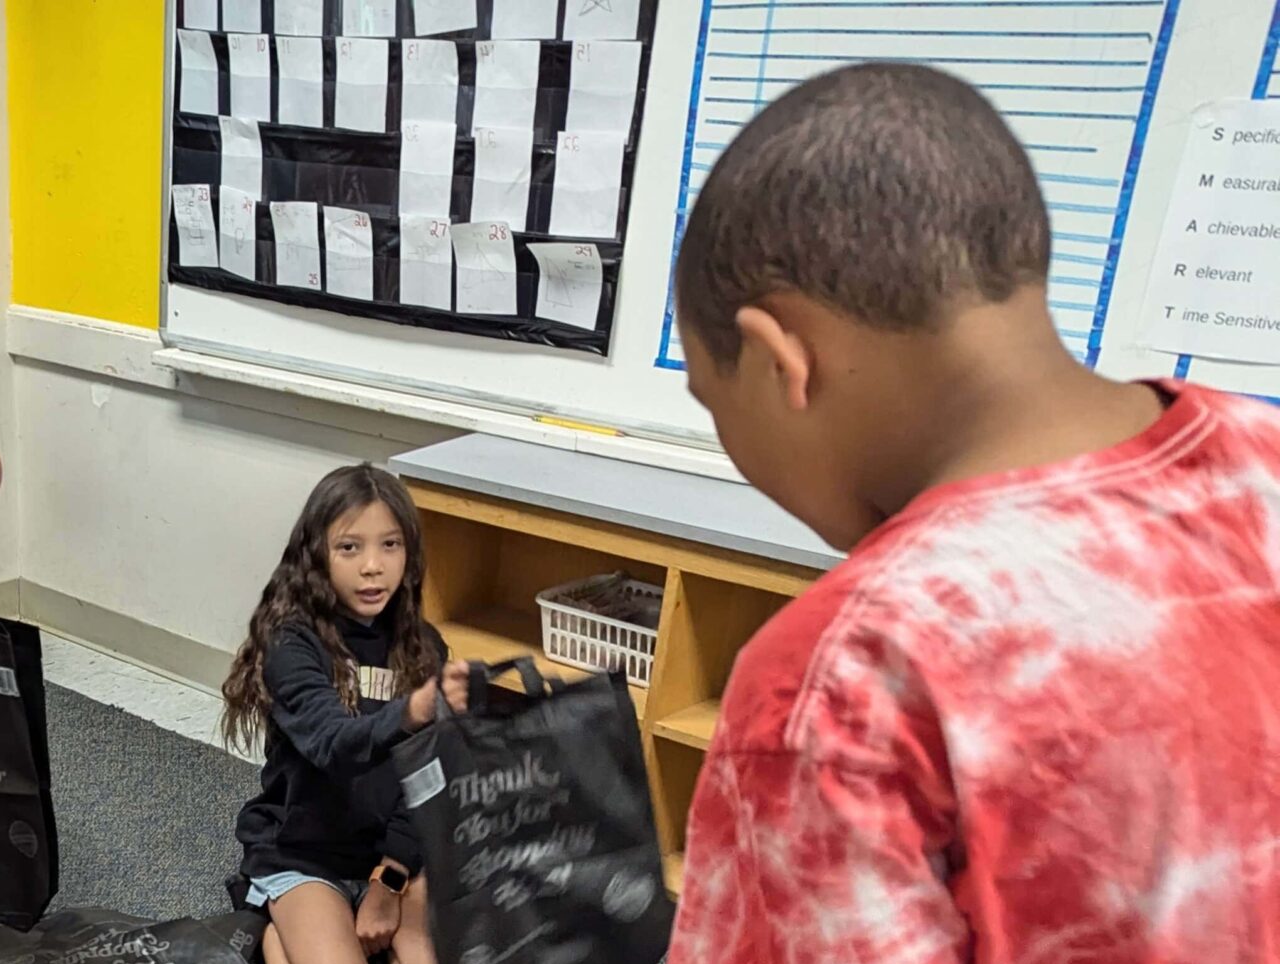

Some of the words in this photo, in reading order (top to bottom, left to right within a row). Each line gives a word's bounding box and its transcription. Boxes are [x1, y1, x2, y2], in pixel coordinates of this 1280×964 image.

[1212, 127, 1225, 141] S
[1198, 173, 1214, 188] M
[197, 187, 209, 202] 23
[354, 214, 369, 228] 26
[430, 220, 448, 237] 27
[1186, 219, 1198, 233] A
[489, 225, 508, 241] 28
[575, 245, 593, 257] 29
[308, 272, 319, 285] 25
[1173, 263, 1188, 278] R
[1195, 265, 1253, 284] elevant
[1164, 306, 1176, 319] T
[1182, 307, 1209, 324] ime
[449, 750, 561, 809] Thank
